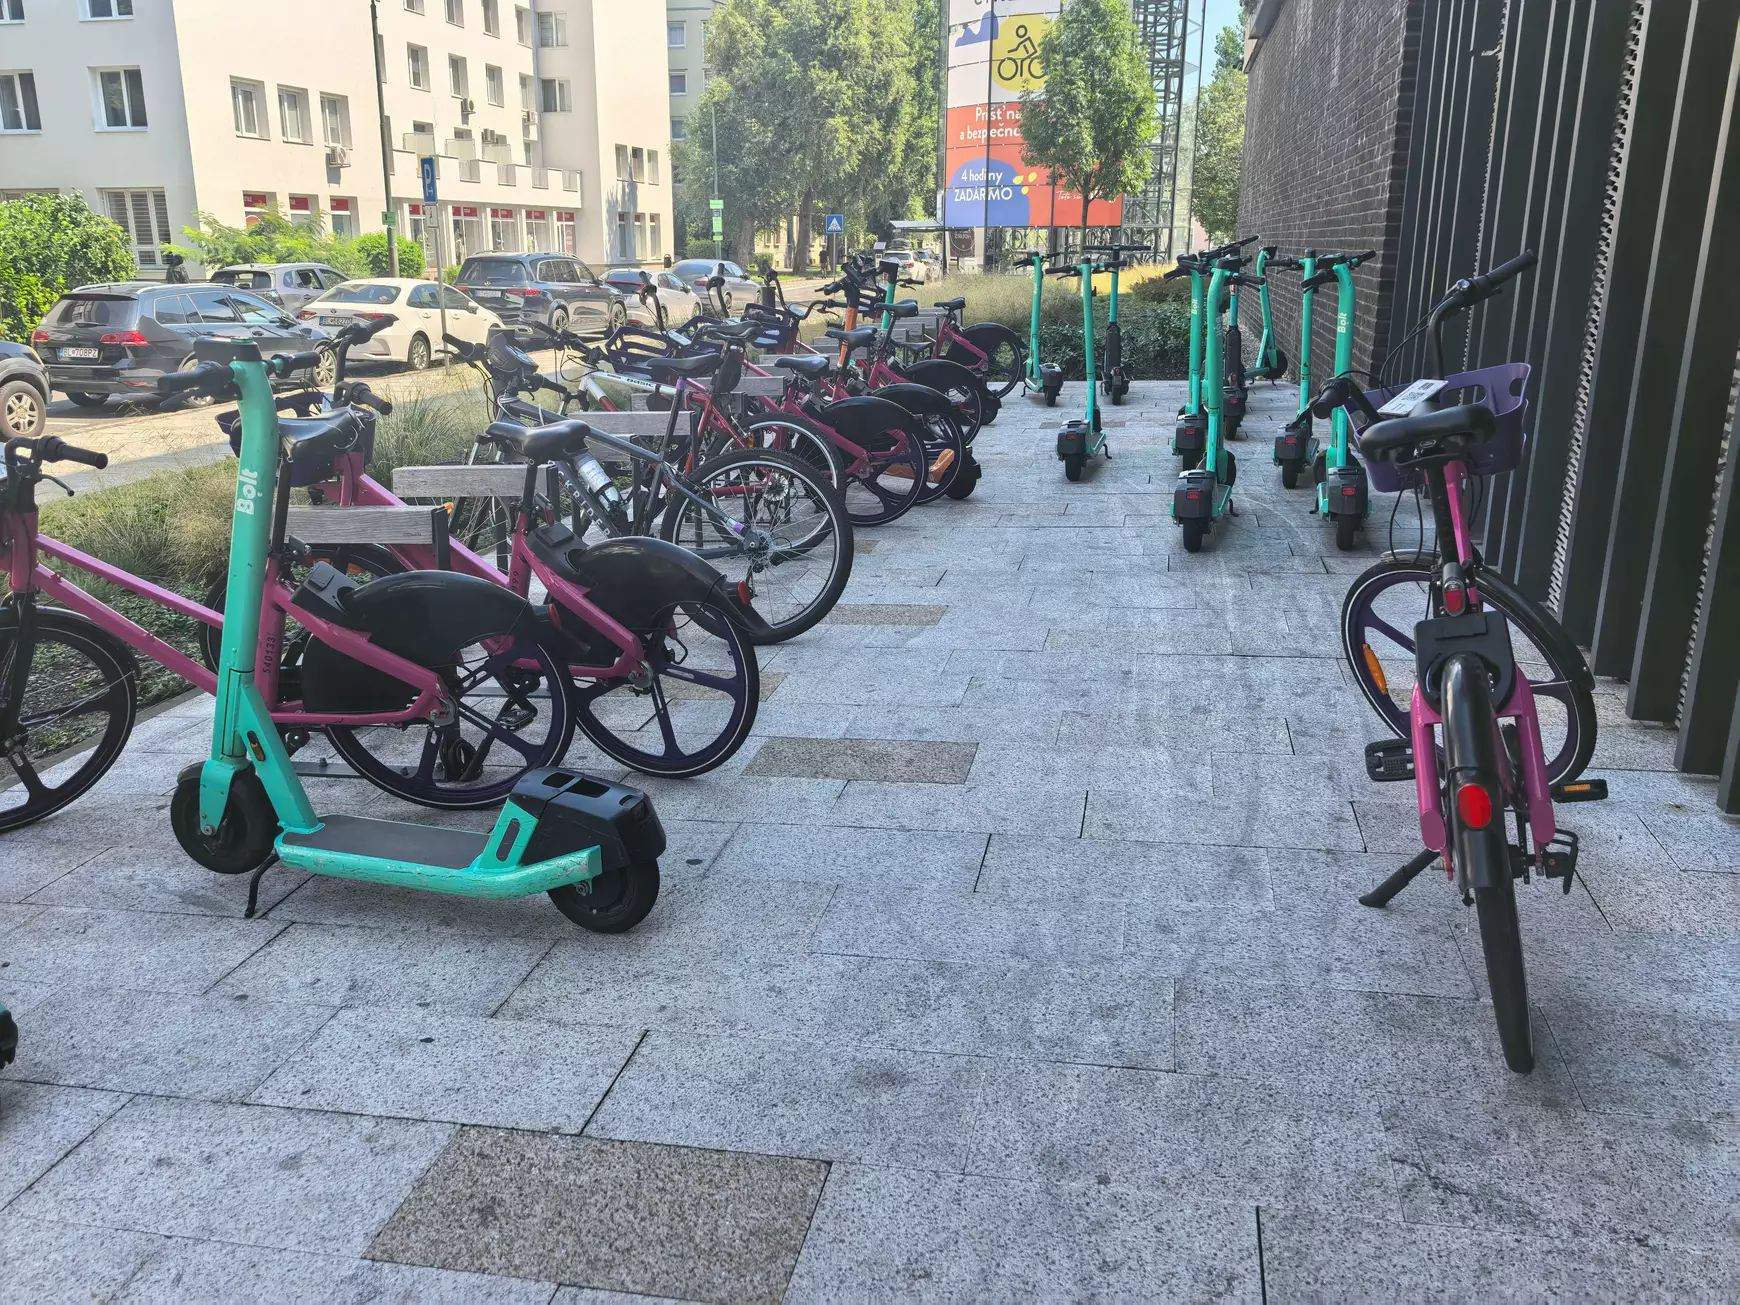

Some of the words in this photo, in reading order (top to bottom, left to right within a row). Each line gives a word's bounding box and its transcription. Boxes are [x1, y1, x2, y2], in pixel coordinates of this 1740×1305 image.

[959, 131, 965, 141] a
[424, 163, 433, 196] P
[961, 169, 968, 182] 4
[969, 168, 1003, 185] hodiny
[1191, 299, 1199, 315] Bolt
[1337, 312, 1348, 333] Bolt
[237, 468, 260, 515] Bolt
